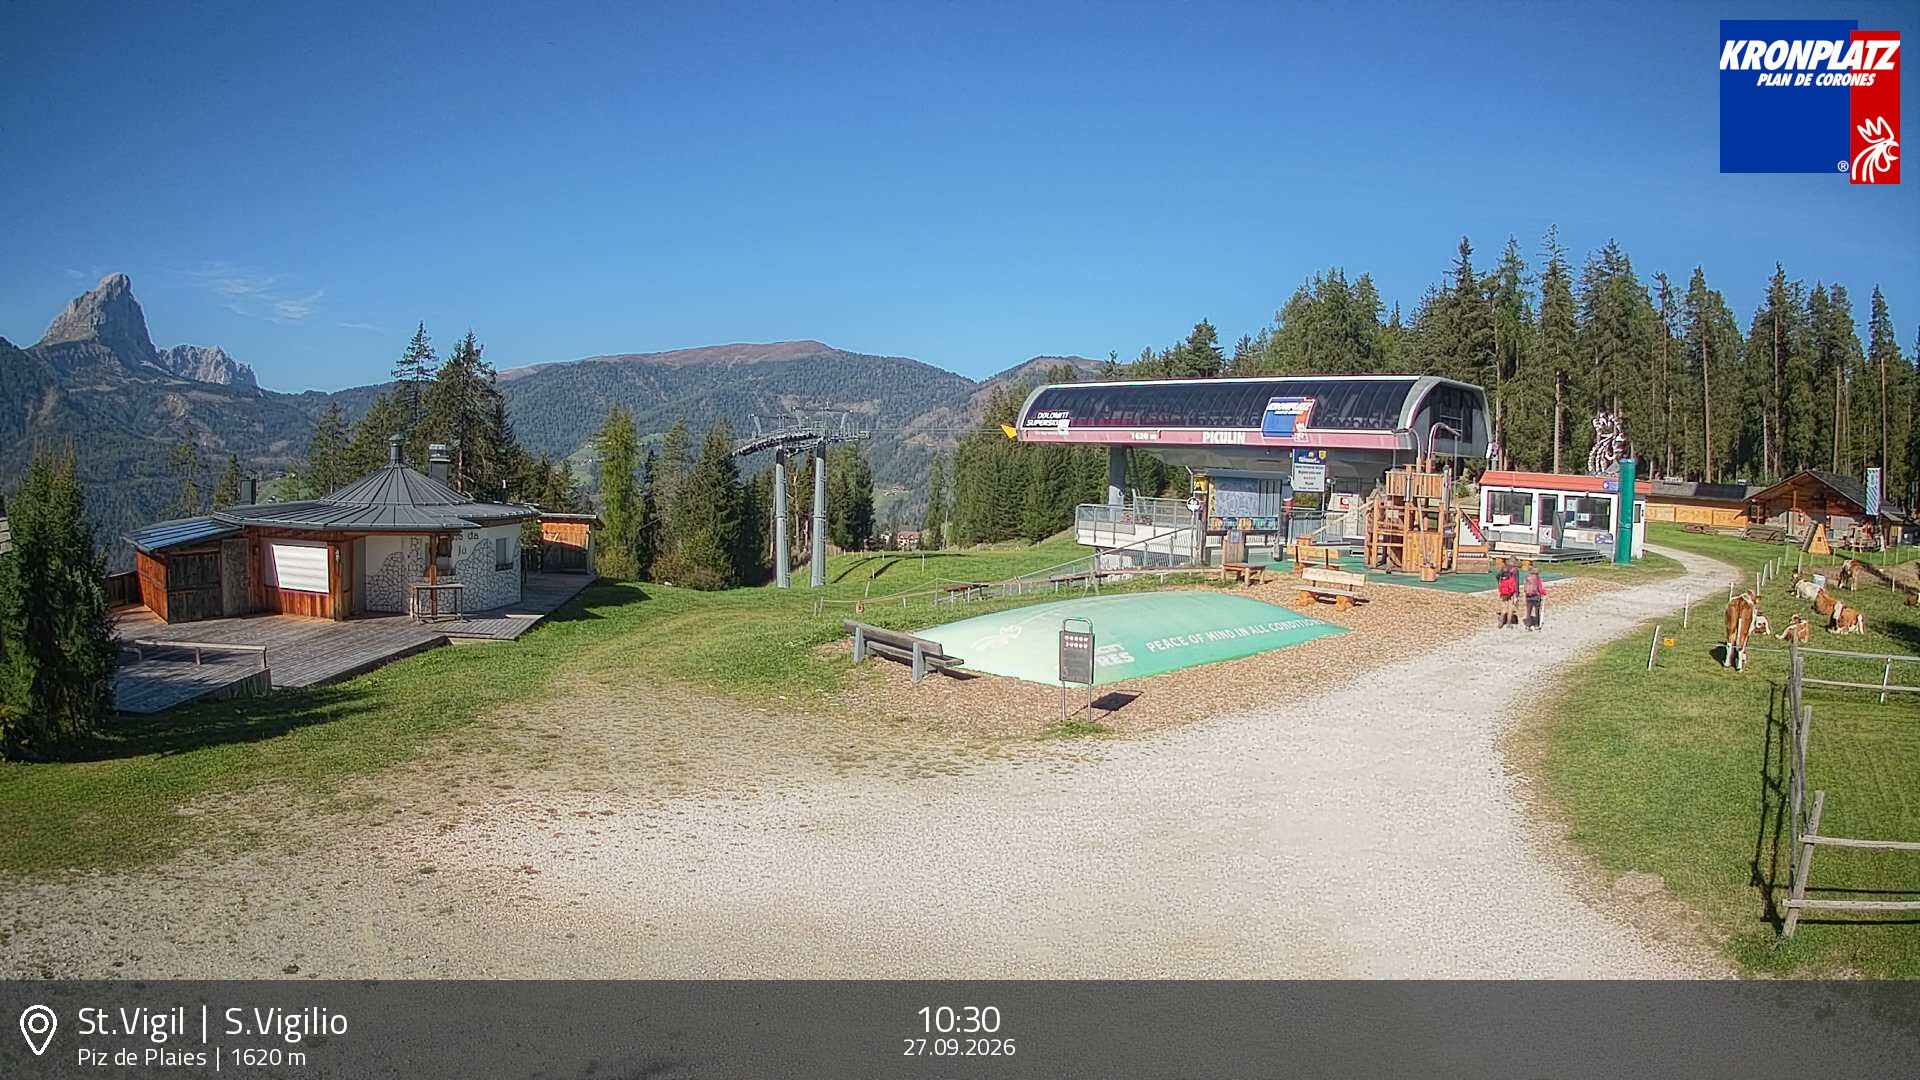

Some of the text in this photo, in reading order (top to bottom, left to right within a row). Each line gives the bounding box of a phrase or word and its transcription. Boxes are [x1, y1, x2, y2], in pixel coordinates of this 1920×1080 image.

[1202, 431, 1246, 444] PICULIN
[1145, 636, 1189, 653] PEACE
[1187, 633, 1205, 644] OF
[1205, 629, 1236, 641] MIND
[1233, 627, 1250, 638] IN
[1248, 624, 1270, 635] ALL
